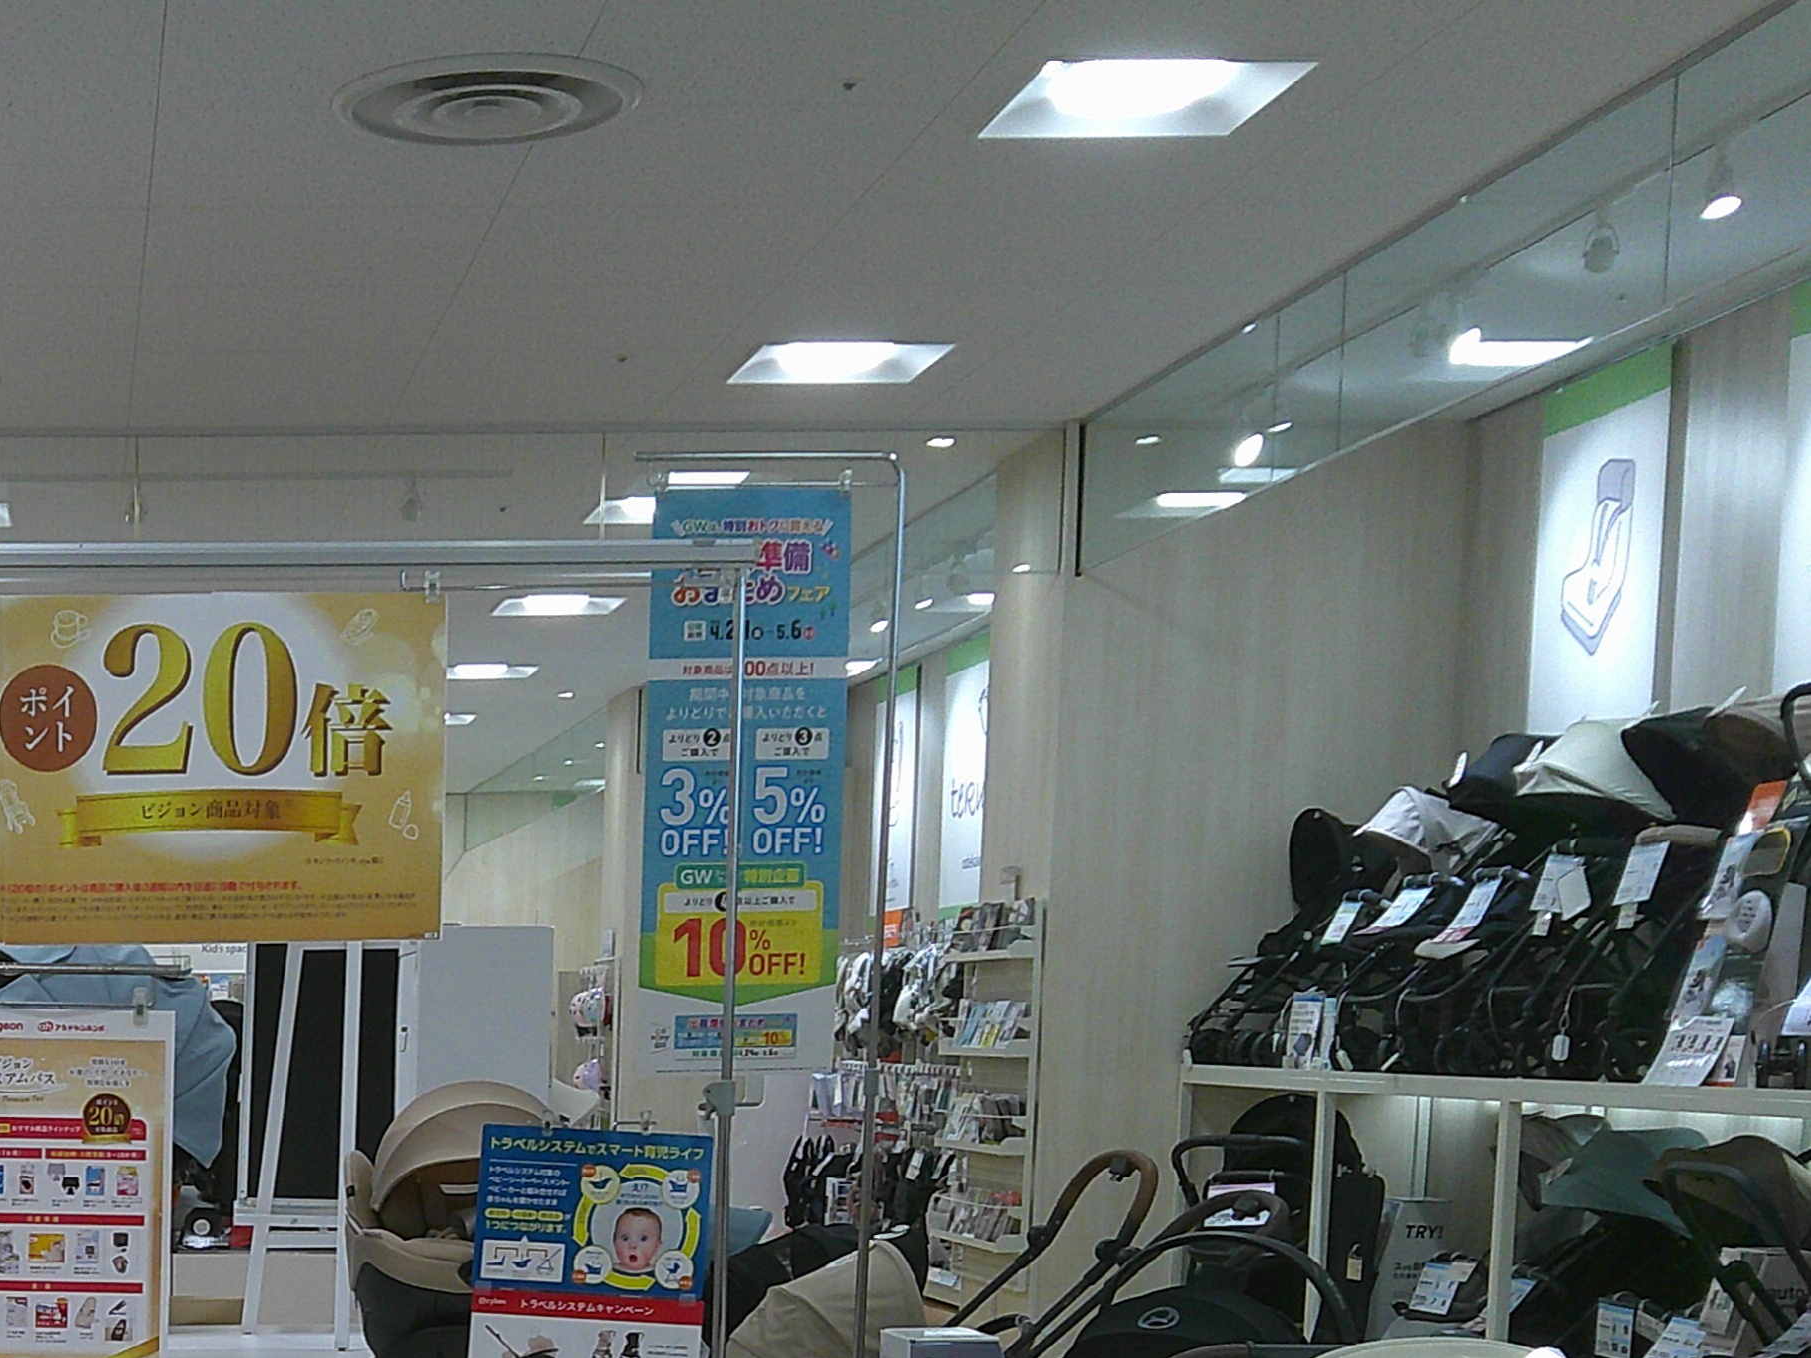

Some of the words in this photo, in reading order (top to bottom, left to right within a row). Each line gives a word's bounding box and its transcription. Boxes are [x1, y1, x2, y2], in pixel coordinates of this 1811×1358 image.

[753, 765, 827, 826] 5%
[752, 828, 822, 855] OFF!
[680, 869, 713, 885] GW
[748, 953, 806, 977] OFF!
[1406, 1224, 1444, 1239] TRY!
[520, 1298, 654, 1316] トラベルシステムキャンペーン
